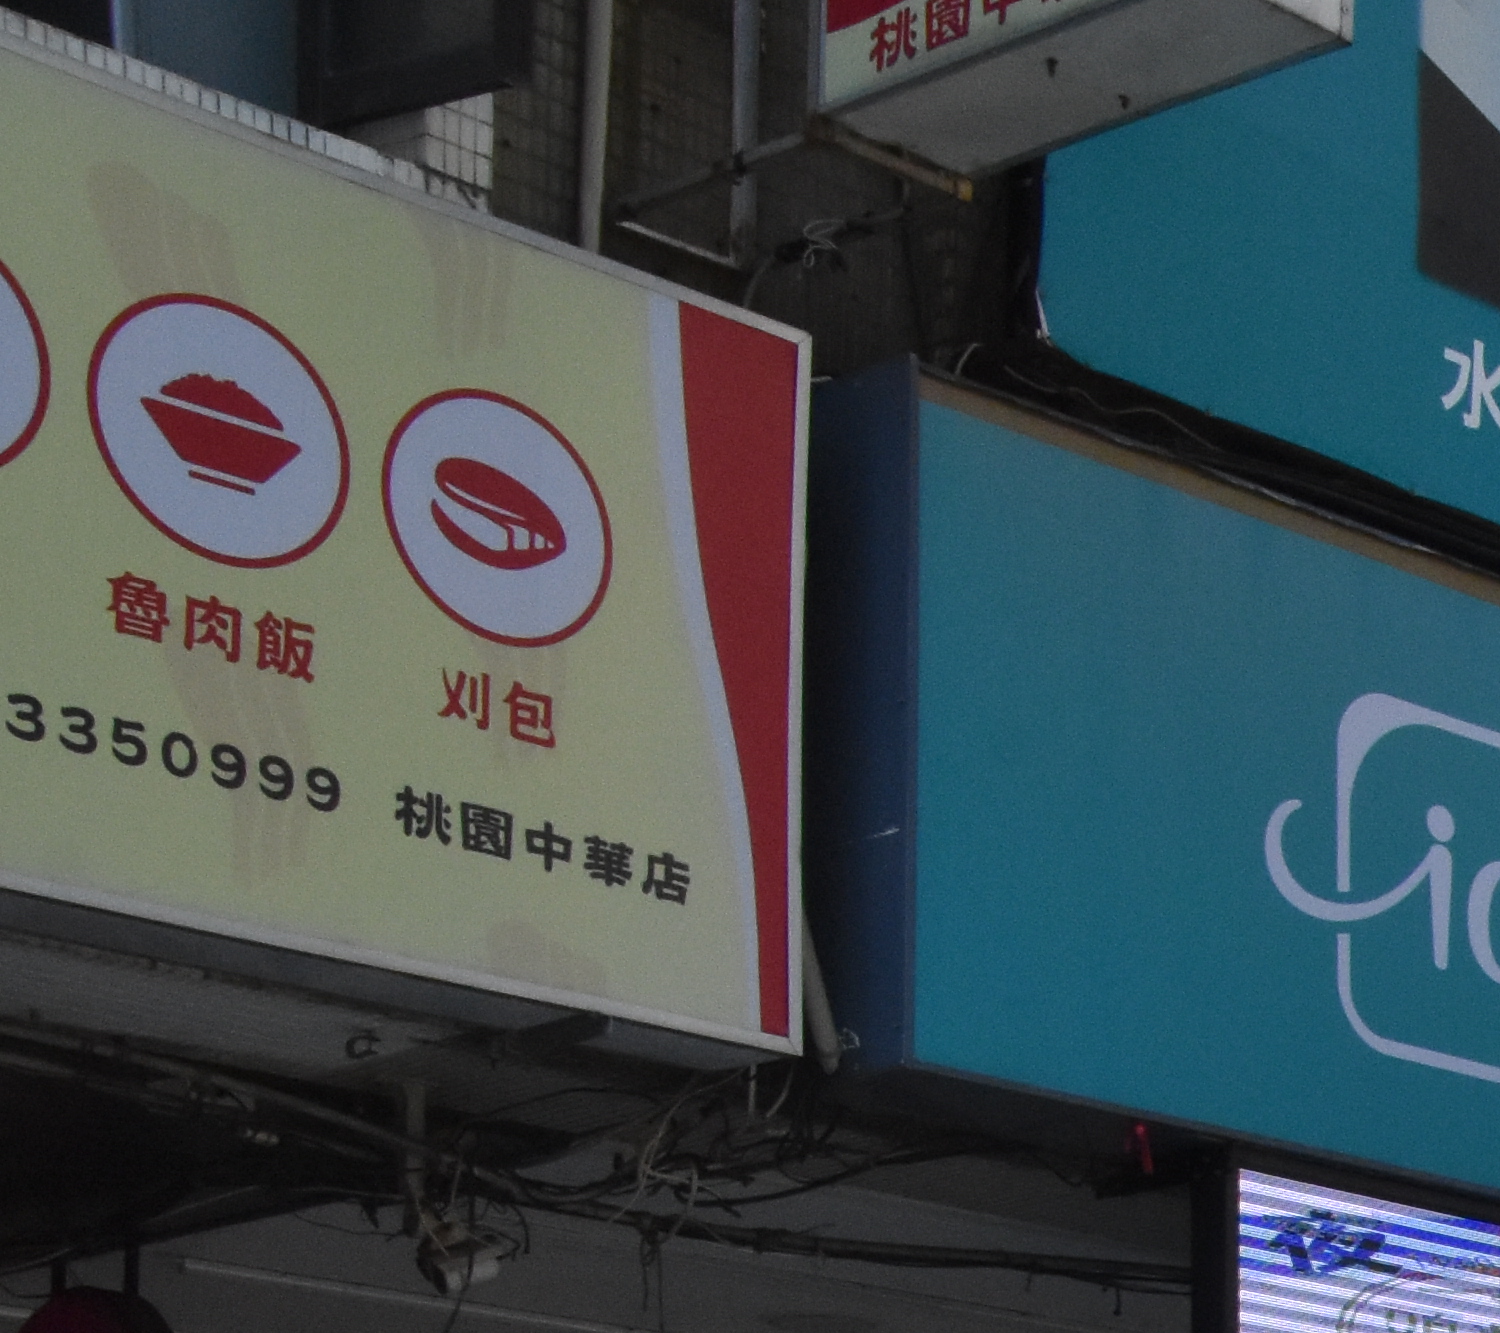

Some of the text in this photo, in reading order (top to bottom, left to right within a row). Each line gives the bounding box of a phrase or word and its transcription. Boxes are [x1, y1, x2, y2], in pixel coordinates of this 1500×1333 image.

[105, 570, 316, 683] 魯肉飯
[438, 667, 557, 749] 刈包
[4, 692, 691, 906] 3350999 桃園中華店
